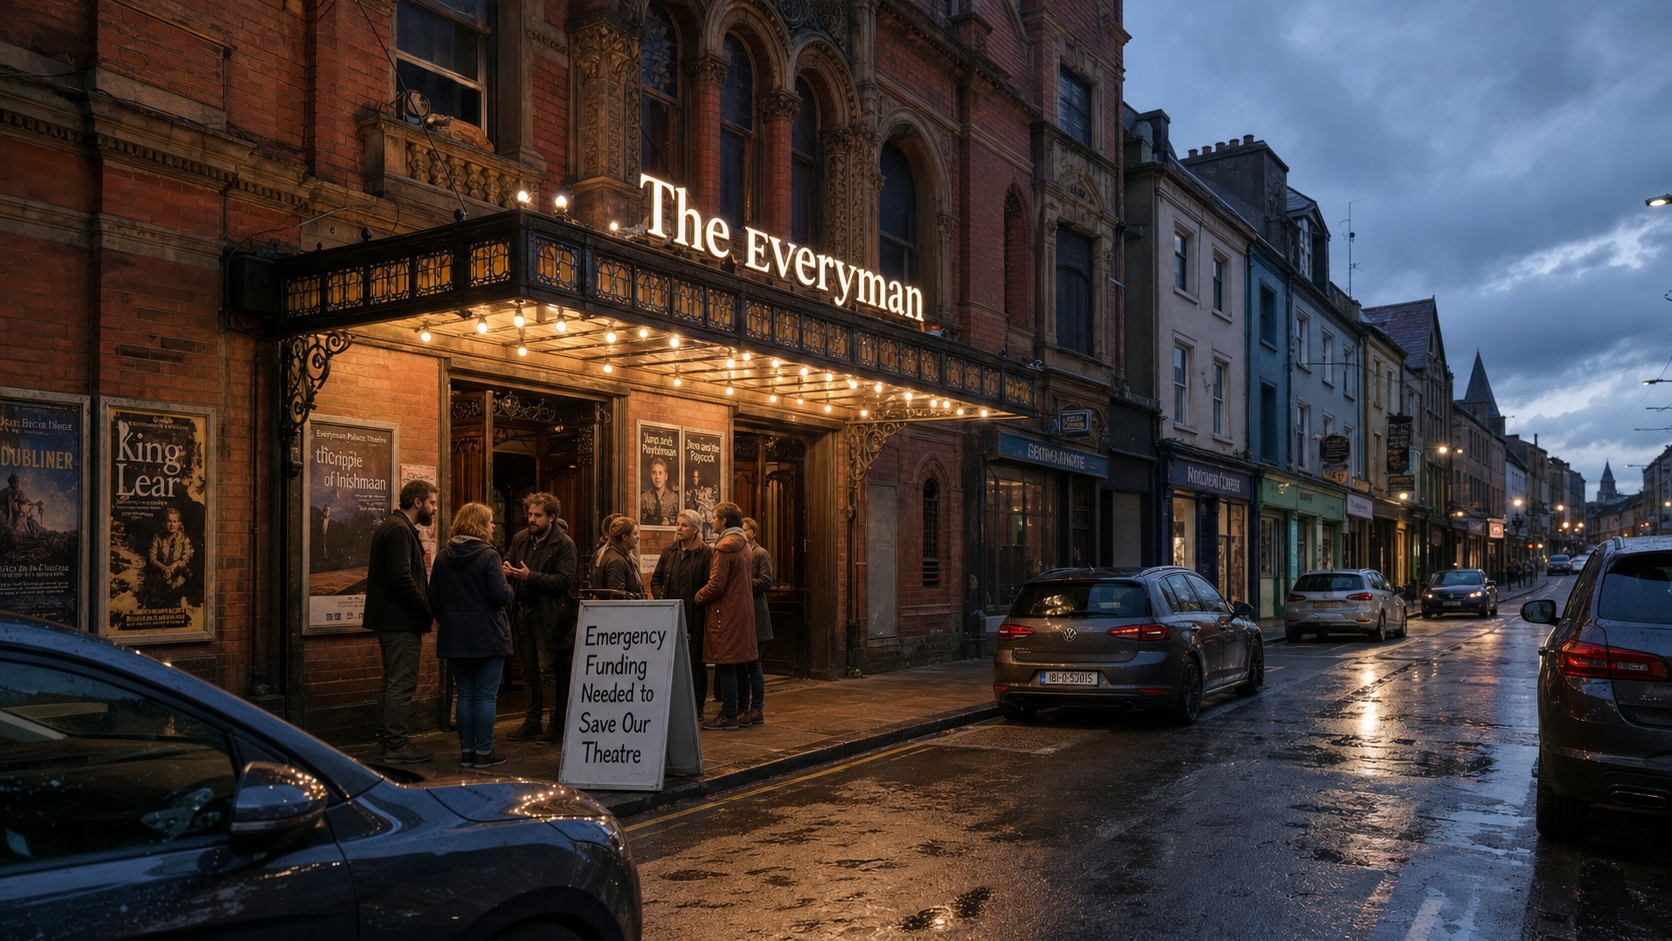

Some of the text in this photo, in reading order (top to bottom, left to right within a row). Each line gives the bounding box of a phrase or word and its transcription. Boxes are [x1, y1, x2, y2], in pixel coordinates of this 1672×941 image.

[640, 173, 925, 322] The Everyman
[1, 445, 73, 470] DUBLINER
[116, 420, 183, 475] King
[116, 463, 181, 498] Lear
[324, 471, 336, 487] of
[336, 471, 386, 491] Inishmaan
[585, 625, 667, 651] Emergency
[585, 653, 647, 681] Funding
[581, 682, 654, 704] Needed to
[579, 711, 651, 734] Save Our
[582, 740, 641, 764] Theatre
